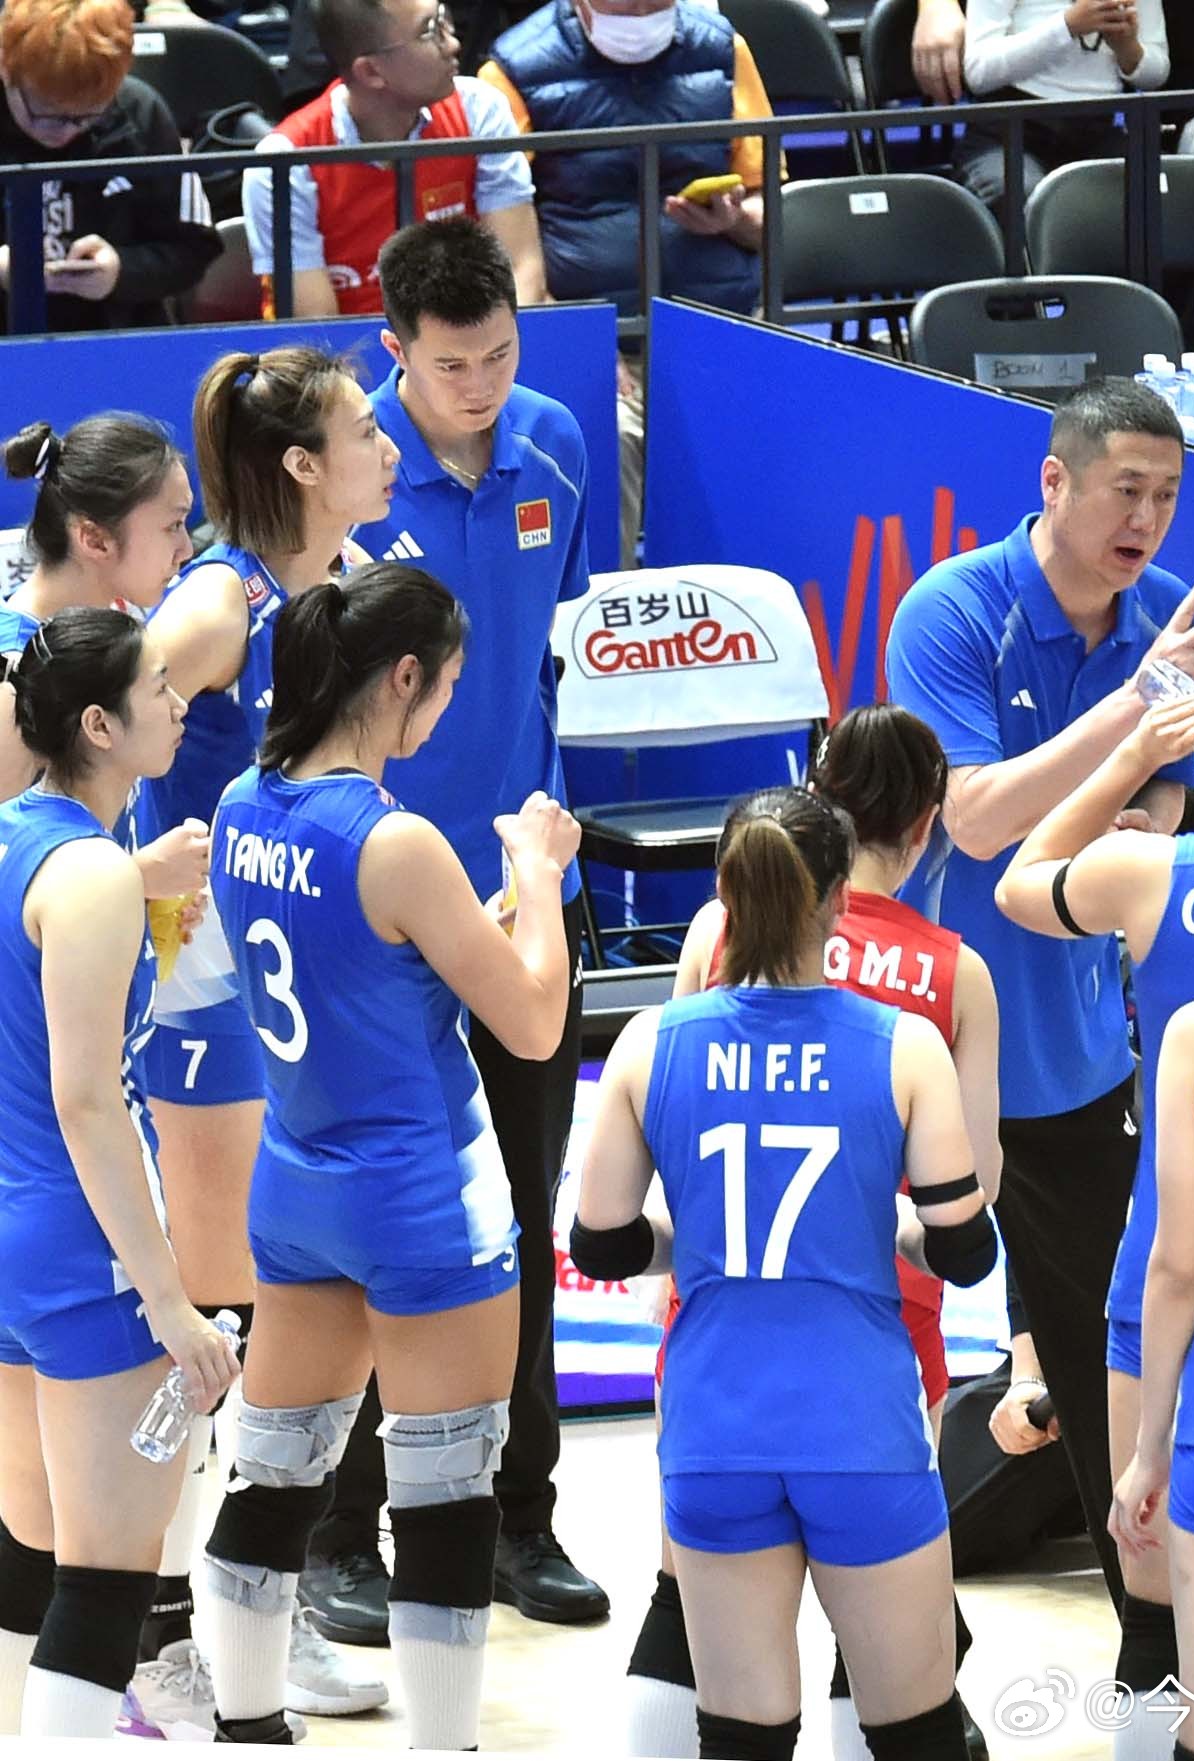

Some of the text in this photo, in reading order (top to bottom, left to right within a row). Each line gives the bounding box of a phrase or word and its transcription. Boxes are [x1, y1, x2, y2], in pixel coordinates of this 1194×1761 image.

[523, 531, 547, 545] CHN
[600, 591, 710, 629] 百岁山
[225, 825, 321, 898] TANG X.
[246, 918, 308, 1063] 3
[858, 940, 937, 1002] M.J.
[181, 1039, 208, 1089] 7
[706, 1042, 830, 1092] NI F.F.
[699, 1122, 841, 1281] 17
